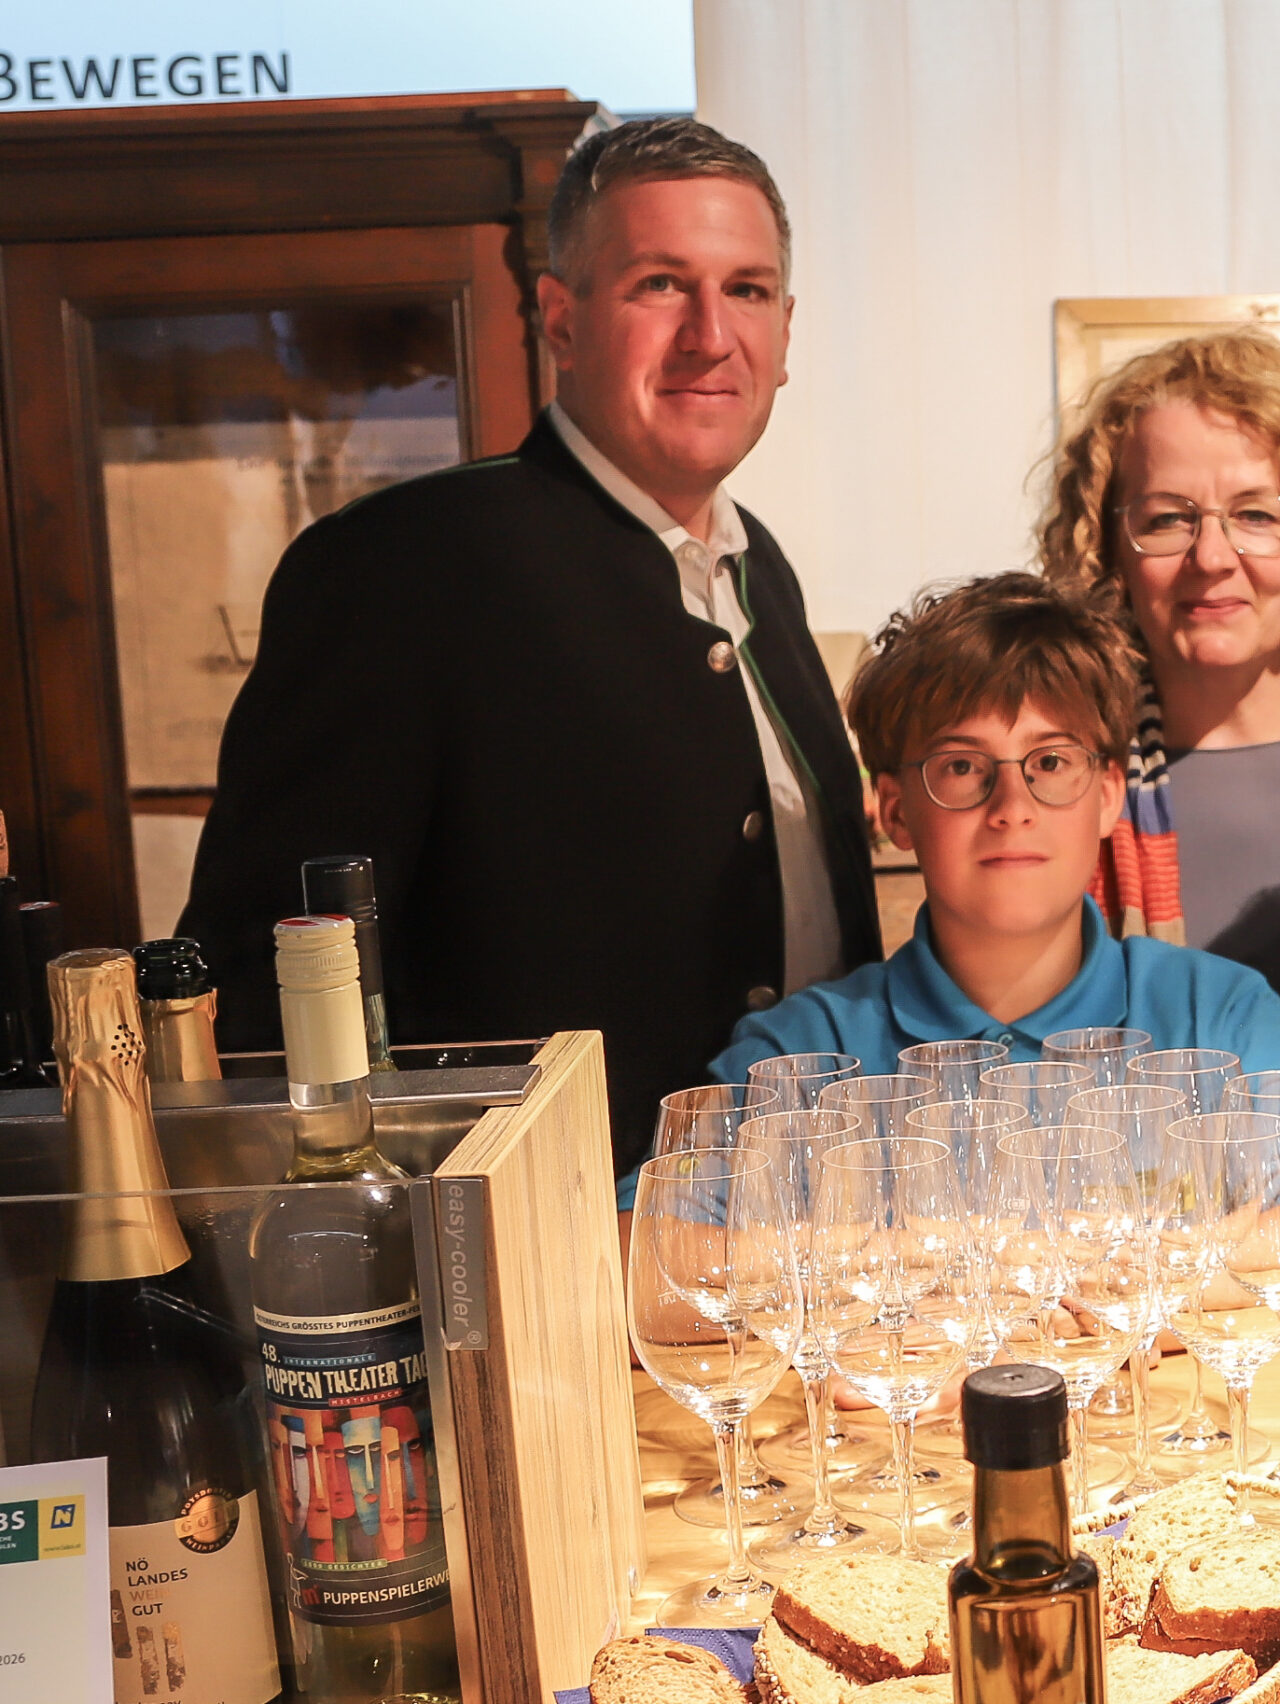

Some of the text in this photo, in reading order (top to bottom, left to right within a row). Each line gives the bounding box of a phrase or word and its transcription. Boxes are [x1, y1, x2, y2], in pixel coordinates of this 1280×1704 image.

[446, 1184, 473, 1328] easy-cooler
[261, 1342, 281, 1364] 48.
[264, 1363, 323, 1399] PUPPEN
[323, 1360, 399, 1395] THEATER
[126, 1557, 149, 1572] NÖ
[128, 1568, 188, 1587] LANDES
[132, 1603, 163, 1617] GUT
